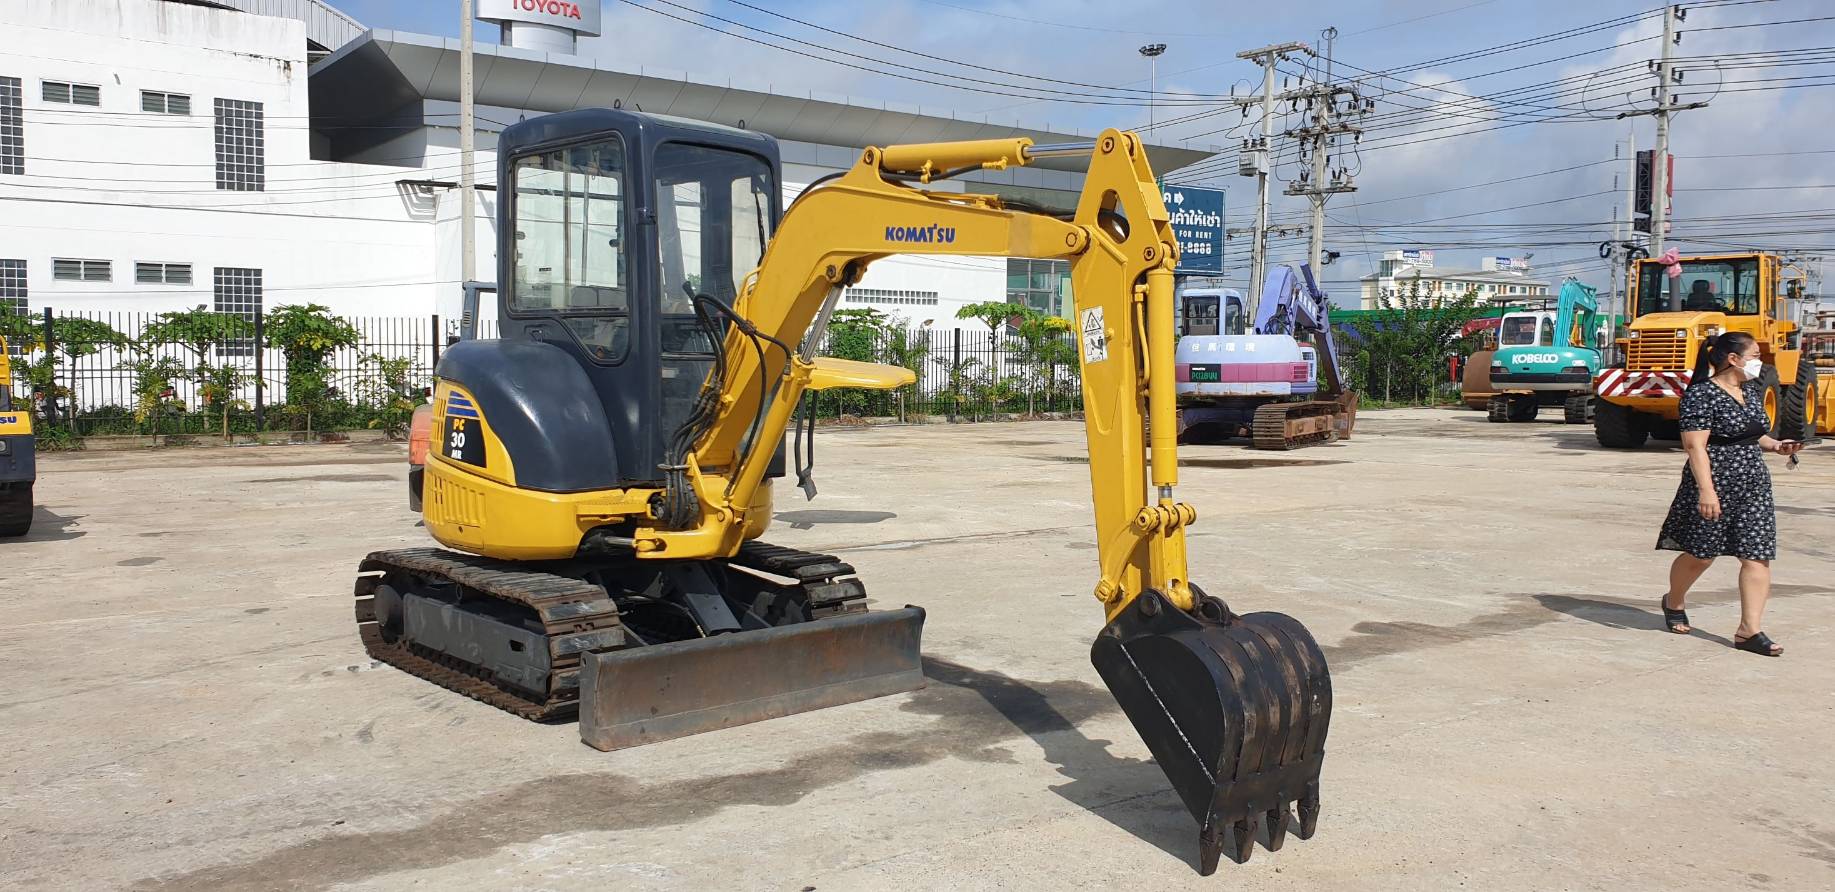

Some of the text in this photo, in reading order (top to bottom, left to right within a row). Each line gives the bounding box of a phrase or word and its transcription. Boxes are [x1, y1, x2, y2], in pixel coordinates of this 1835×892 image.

[1168, 208, 1220, 227] นค้าให้เช่า
[885, 223, 956, 243] KOMATSU
[1179, 230, 1191, 238] FOR
[1195, 231, 1212, 239] RENT
[1512, 354, 1559, 364] KOBELCO
[453, 418, 465, 431] PC
[450, 432, 465, 448] 30
[451, 449, 462, 460] MR
